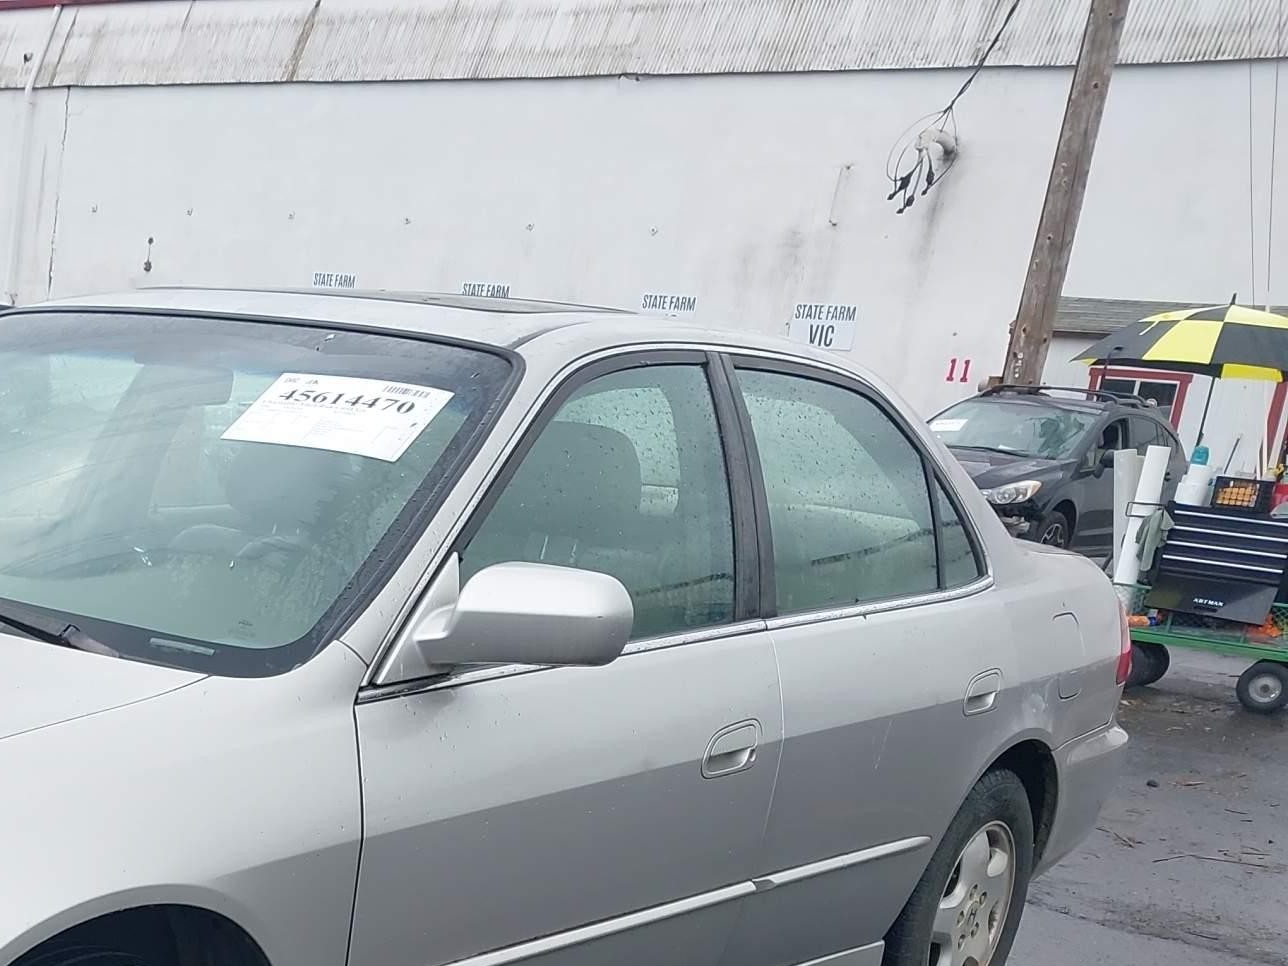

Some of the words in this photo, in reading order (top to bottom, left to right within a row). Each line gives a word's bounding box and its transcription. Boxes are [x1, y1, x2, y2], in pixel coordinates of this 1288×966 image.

[313, 272, 333, 287] STATE
[334, 274, 356, 289] FARM
[462, 283, 485, 296] STATE
[486, 285, 511, 298] FARM
[642, 294, 667, 310] STATE
[668, 296, 697, 312] FARM
[794, 304, 824, 320] STATE
[825, 305, 857, 321] FARM
[808, 324, 835, 348] VIC
[945, 358, 971, 383] 11
[279, 388, 416, 415] 45614470
